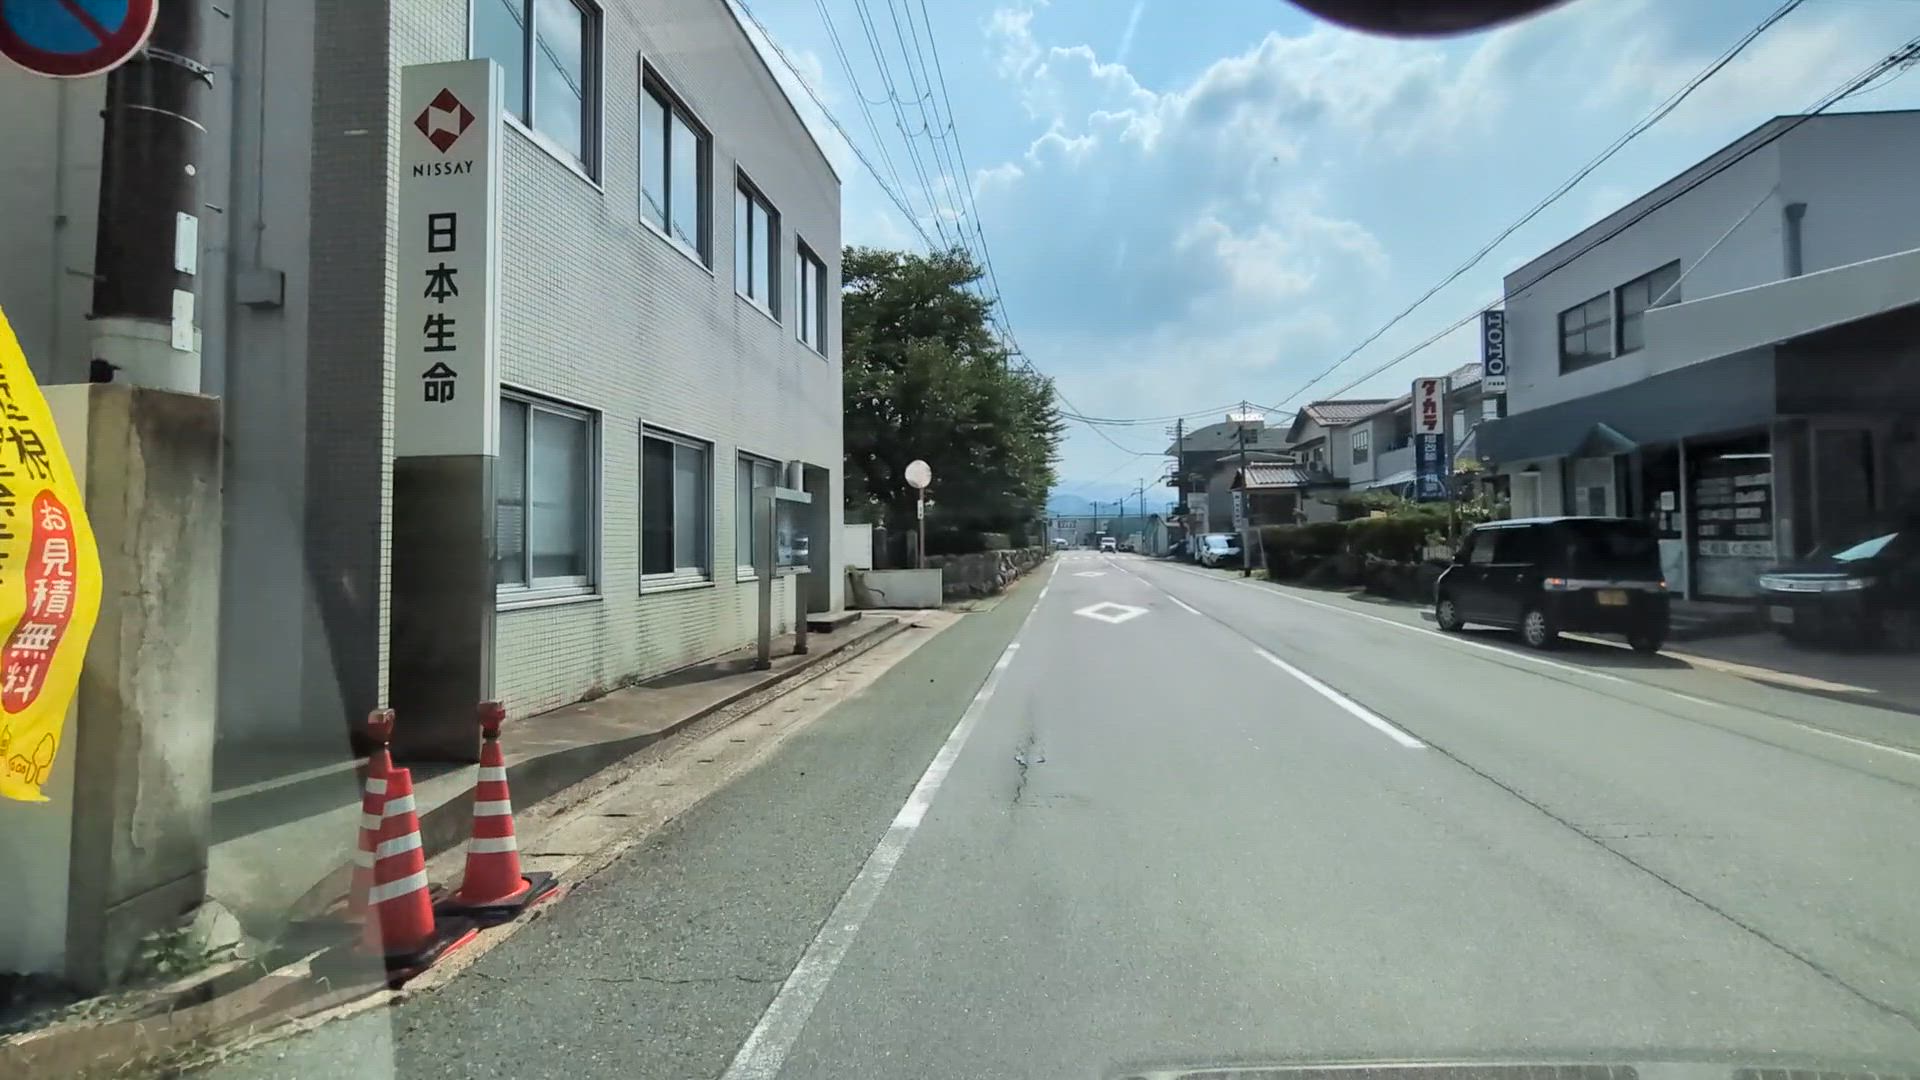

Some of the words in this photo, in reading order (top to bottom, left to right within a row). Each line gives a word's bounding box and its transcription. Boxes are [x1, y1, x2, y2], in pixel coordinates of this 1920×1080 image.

[413, 160, 474, 177] NISSAY
[422, 212, 458, 403] 日本生命
[1488, 313, 1503, 374] TOTO
[1421, 380, 1437, 431] タカラ
[3, 499, 72, 703] お見積無料
